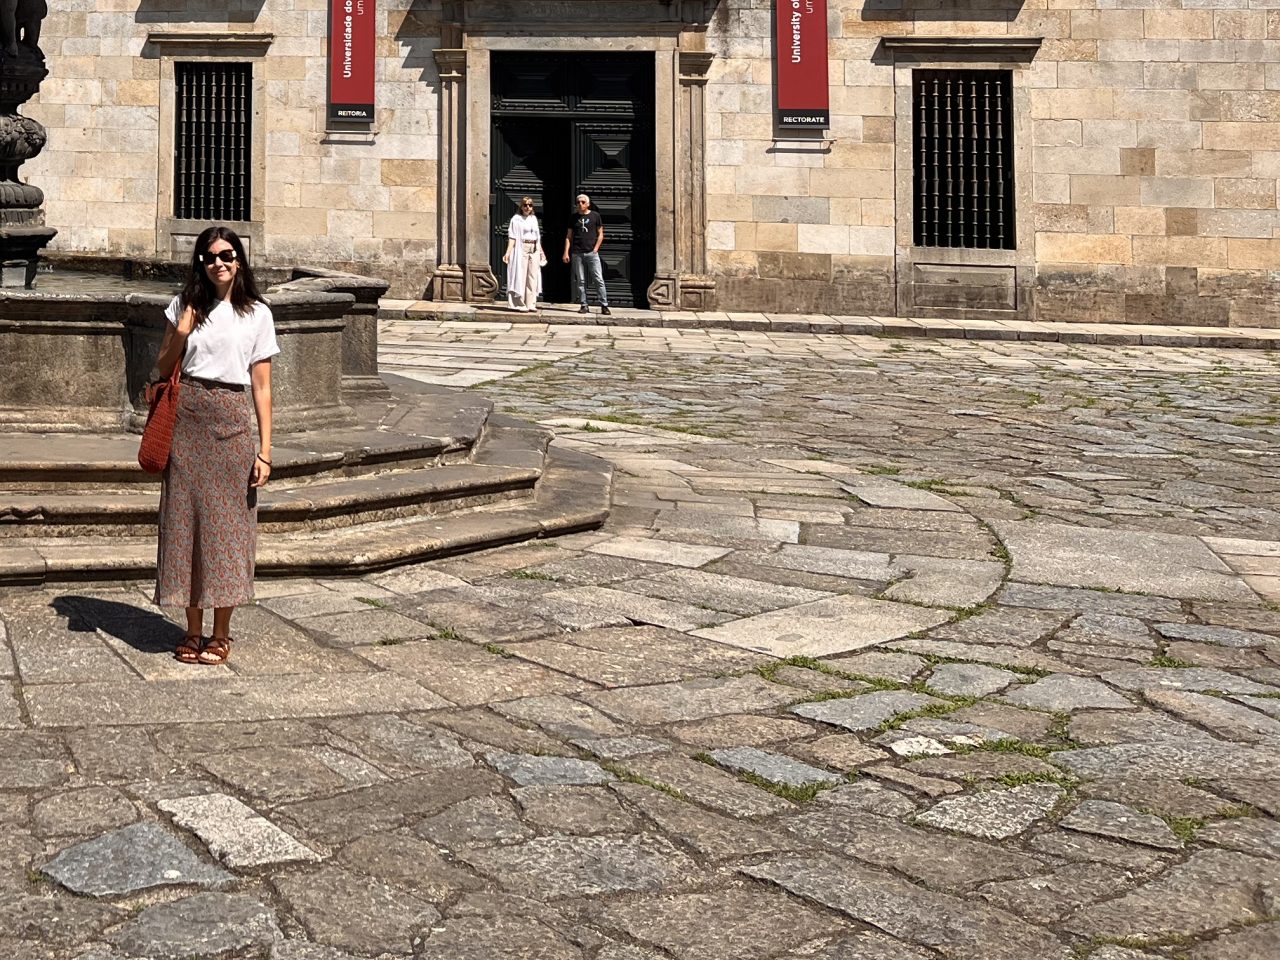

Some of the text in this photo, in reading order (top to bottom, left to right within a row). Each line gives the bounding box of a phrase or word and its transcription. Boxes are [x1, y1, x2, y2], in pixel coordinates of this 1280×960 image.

[343, 0, 353, 13] do
[343, 15, 352, 78] Universidade
[791, 11, 801, 63] University
